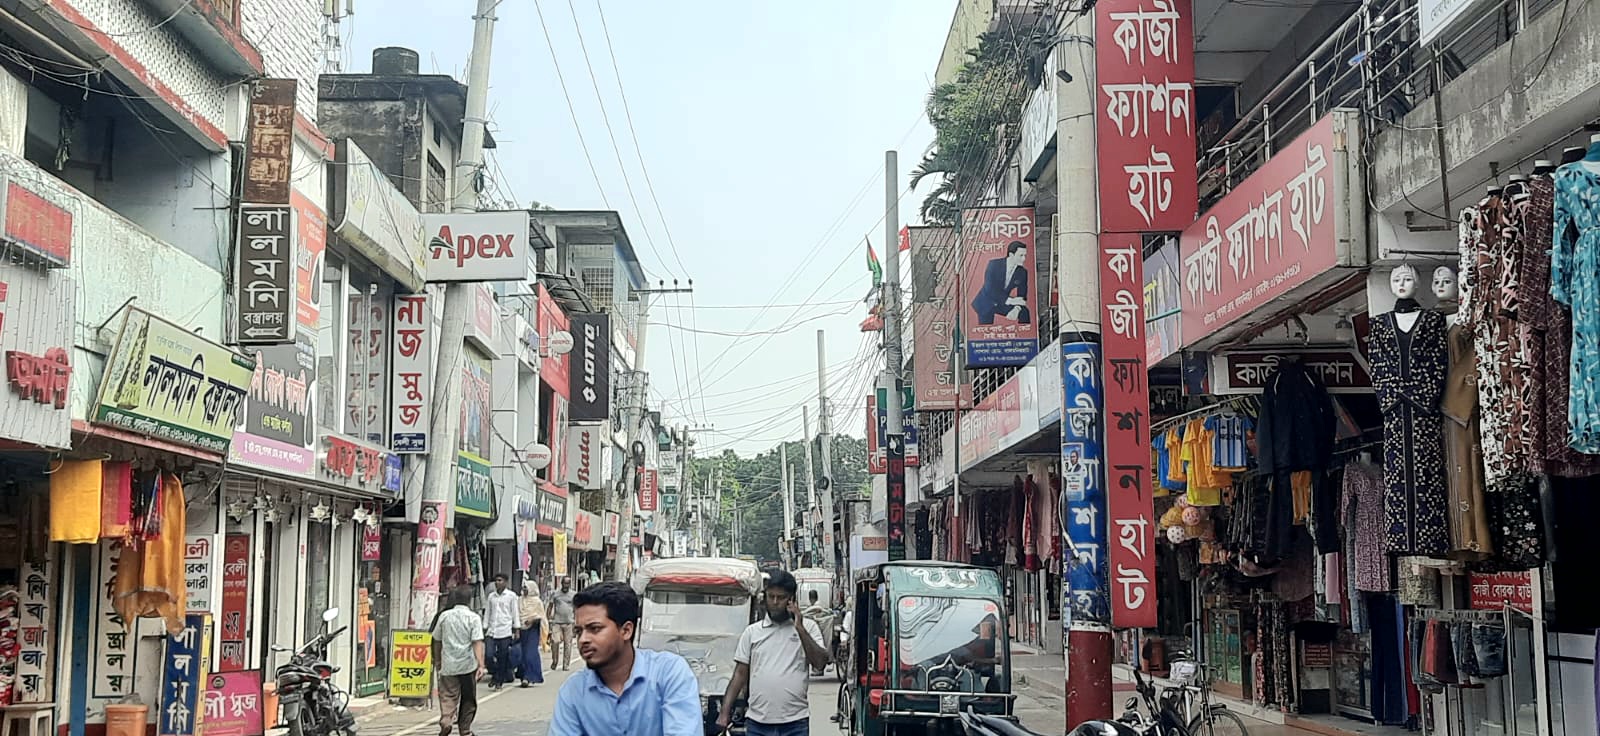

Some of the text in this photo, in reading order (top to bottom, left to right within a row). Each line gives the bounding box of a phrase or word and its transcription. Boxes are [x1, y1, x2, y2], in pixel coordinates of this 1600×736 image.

[1110, 0, 1180, 67] কাজী
[1102, 75, 1192, 138] ফ্যাশন
[1123, 145, 1175, 228] হাট
[430, 225, 514, 268] Apex
[1184, 215, 1222, 310] কাজী
[1225, 190, 1284, 284] ফ্যাশন
[1287, 140, 1328, 252] হাট
[243, 209, 288, 309] লালমনি
[397, 297, 426, 360] নাজ
[584, 323, 595, 385] LOTTO
[143, 353, 204, 424] লালমনি
[578, 430, 590, 486] Bata
[1104, 244, 1150, 610] কাজী ফ্যাশন হাট
[394, 645, 431, 665] নাজ
[230, 692, 258, 718] সুজ
